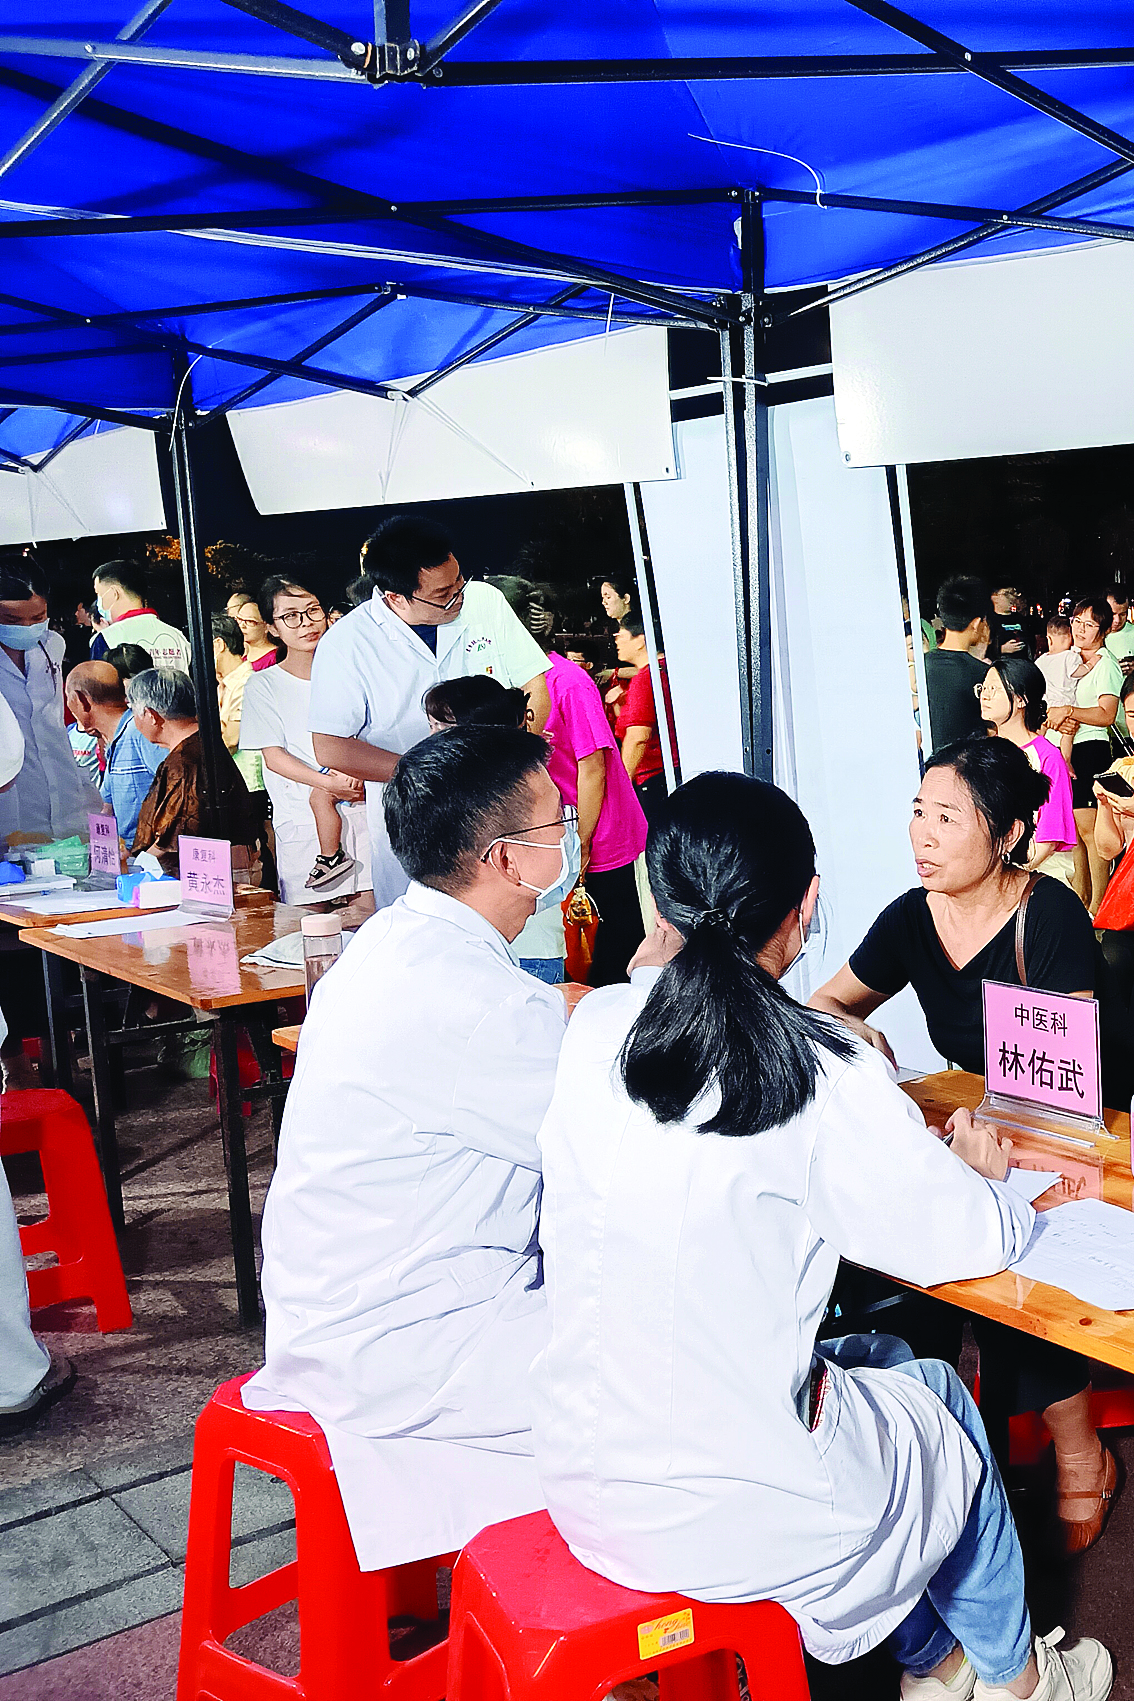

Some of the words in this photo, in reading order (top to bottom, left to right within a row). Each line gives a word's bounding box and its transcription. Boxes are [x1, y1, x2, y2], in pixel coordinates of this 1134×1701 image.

[192, 847, 217, 863] 康复科
[186, 871, 226, 896] 黄永杰
[1014, 1003, 1068, 1037] 中医科
[998, 1041, 1085, 1099] 林佑武
